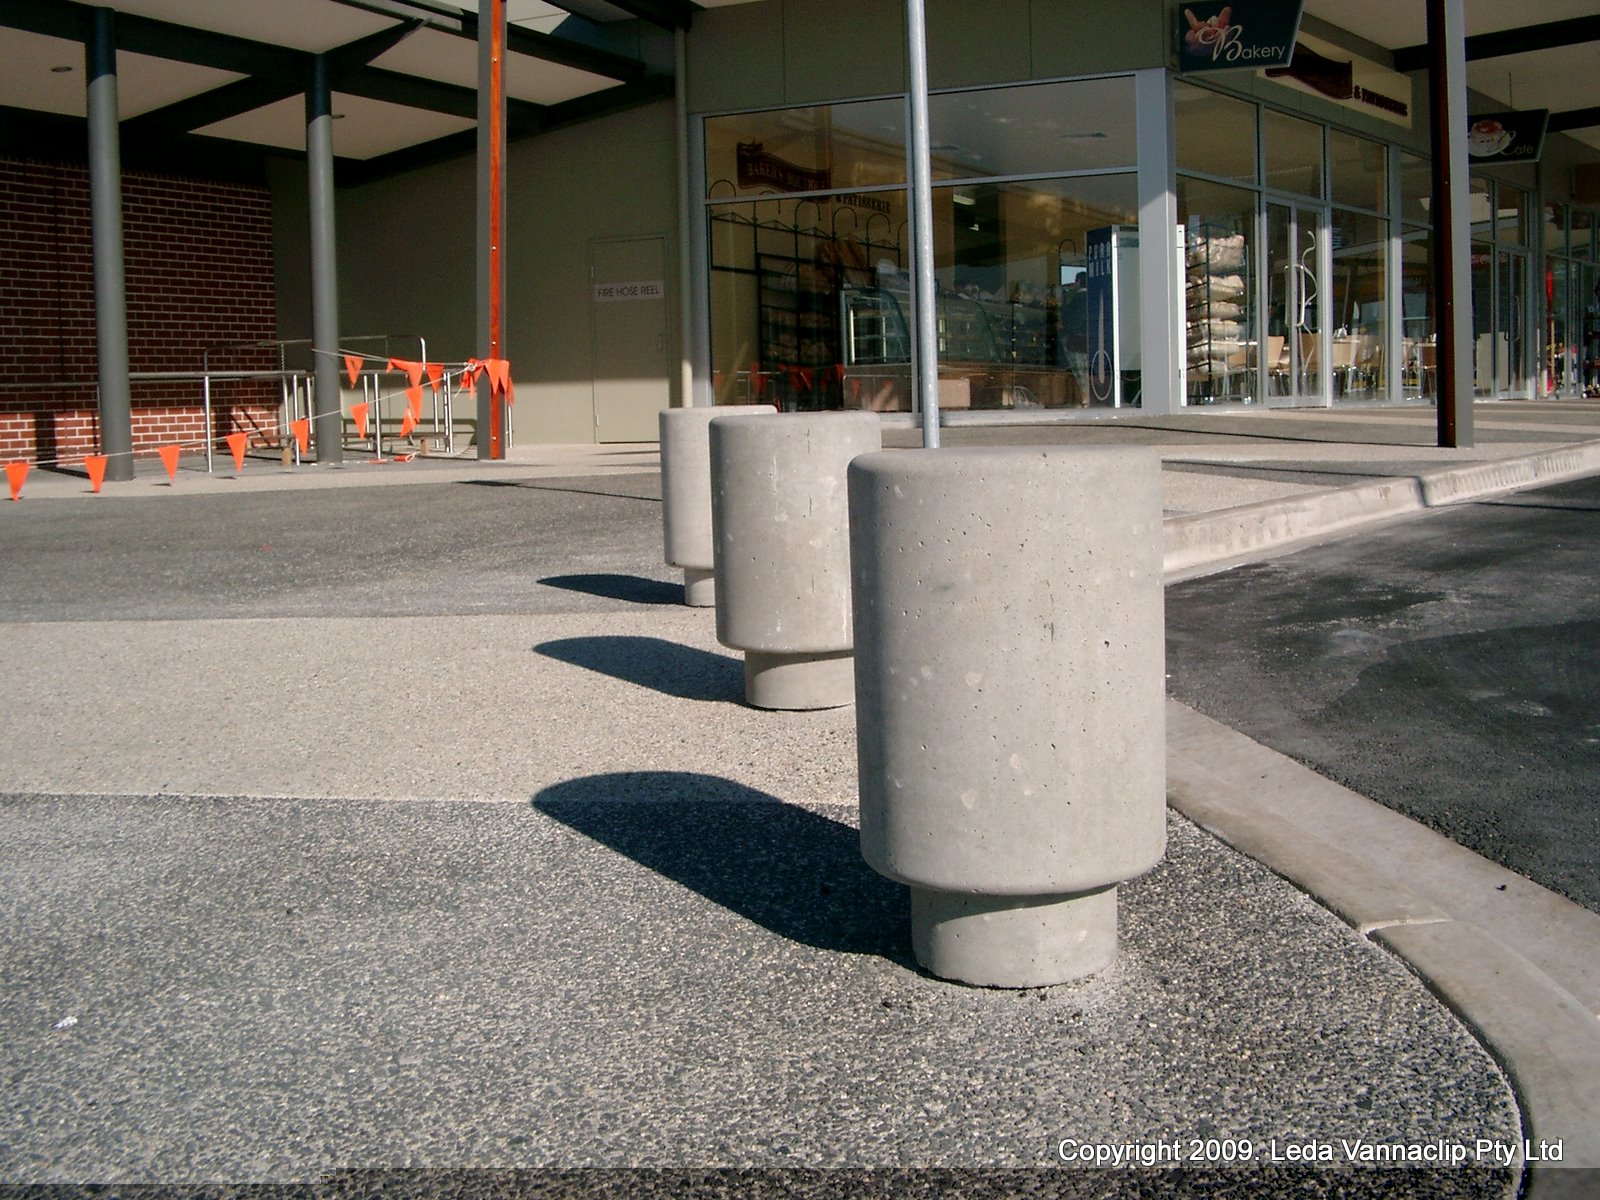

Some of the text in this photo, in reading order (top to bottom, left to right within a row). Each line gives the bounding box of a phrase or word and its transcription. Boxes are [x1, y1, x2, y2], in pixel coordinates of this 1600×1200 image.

[1195, 24, 1286, 62] Bakery
[1088, 259, 1111, 278] MILK
[597, 285, 659, 297] FIRE HOSE REEL
